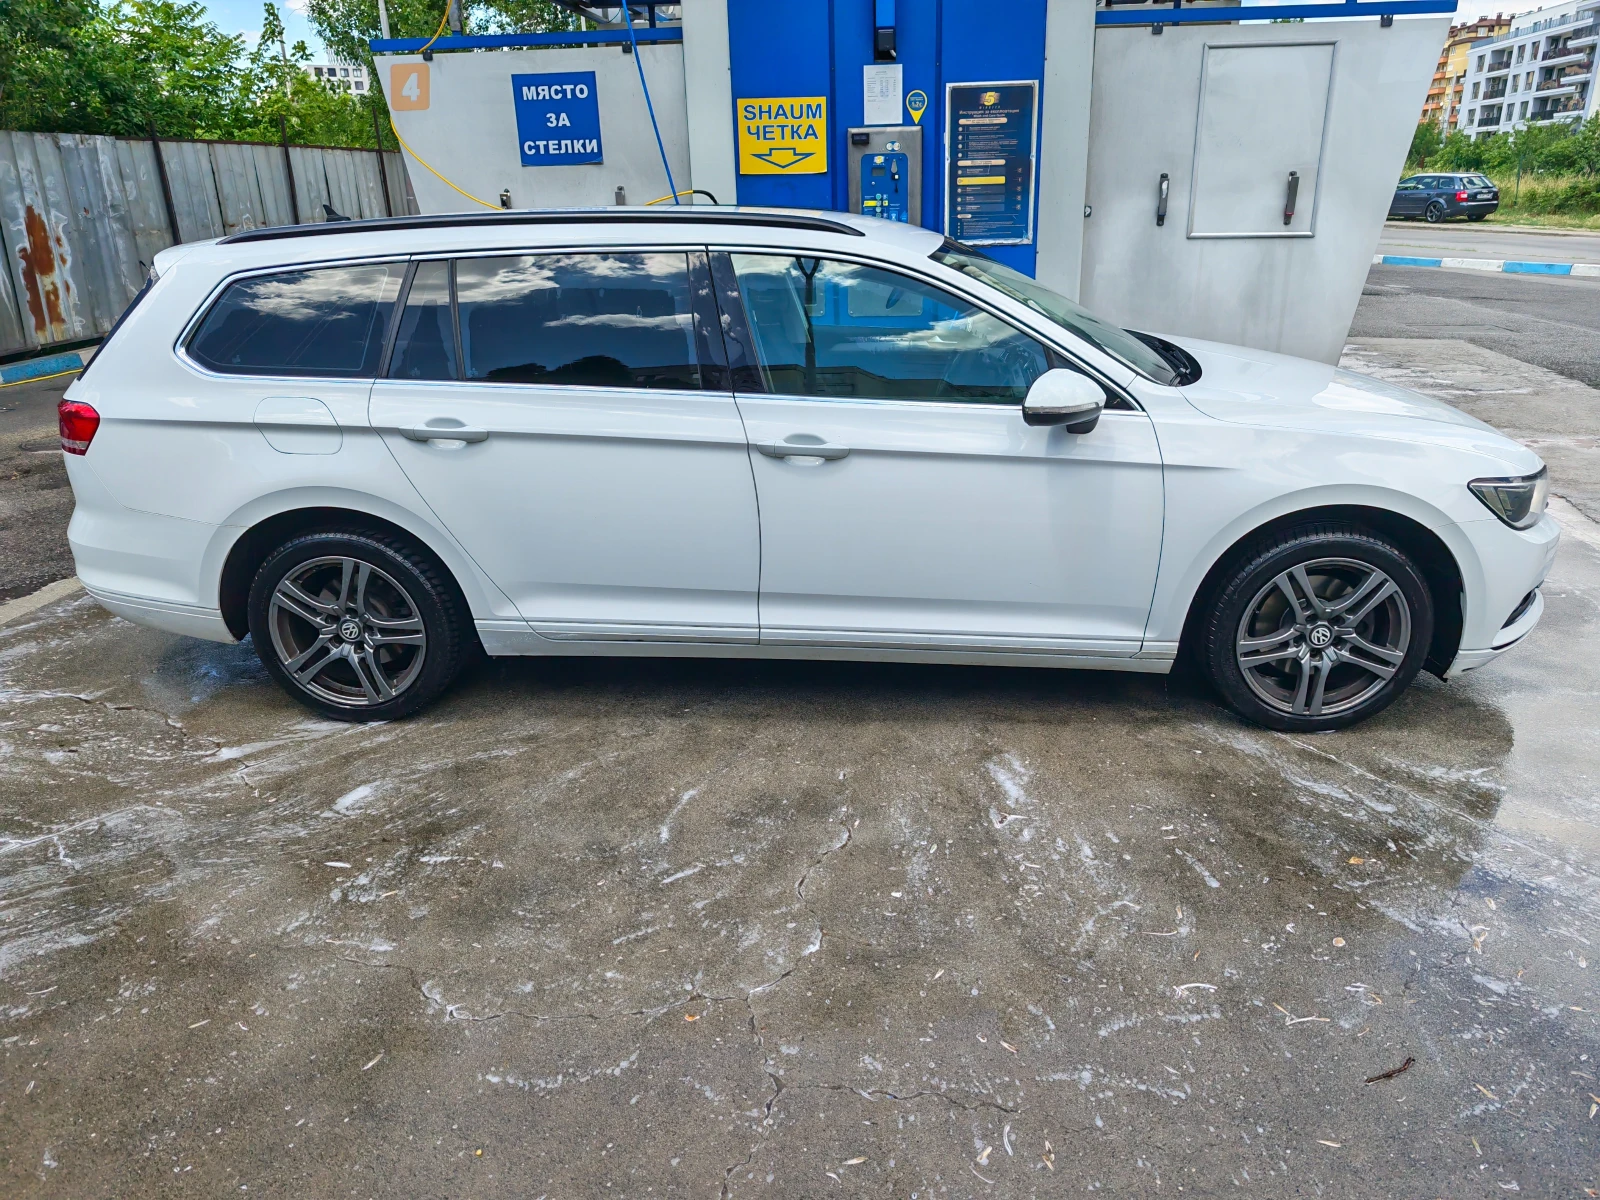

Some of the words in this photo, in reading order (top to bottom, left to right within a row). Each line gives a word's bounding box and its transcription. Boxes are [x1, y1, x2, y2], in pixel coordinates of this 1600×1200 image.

[402, 73, 420, 101] 4
[522, 84, 588, 101] МЯСТО
[984, 92, 995, 105] 5
[546, 113, 571, 127] ЗА
[743, 104, 822, 120] SHAUM
[747, 123, 819, 141] ЧЕТКА
[523, 139, 598, 155] СТЕЛКИ
